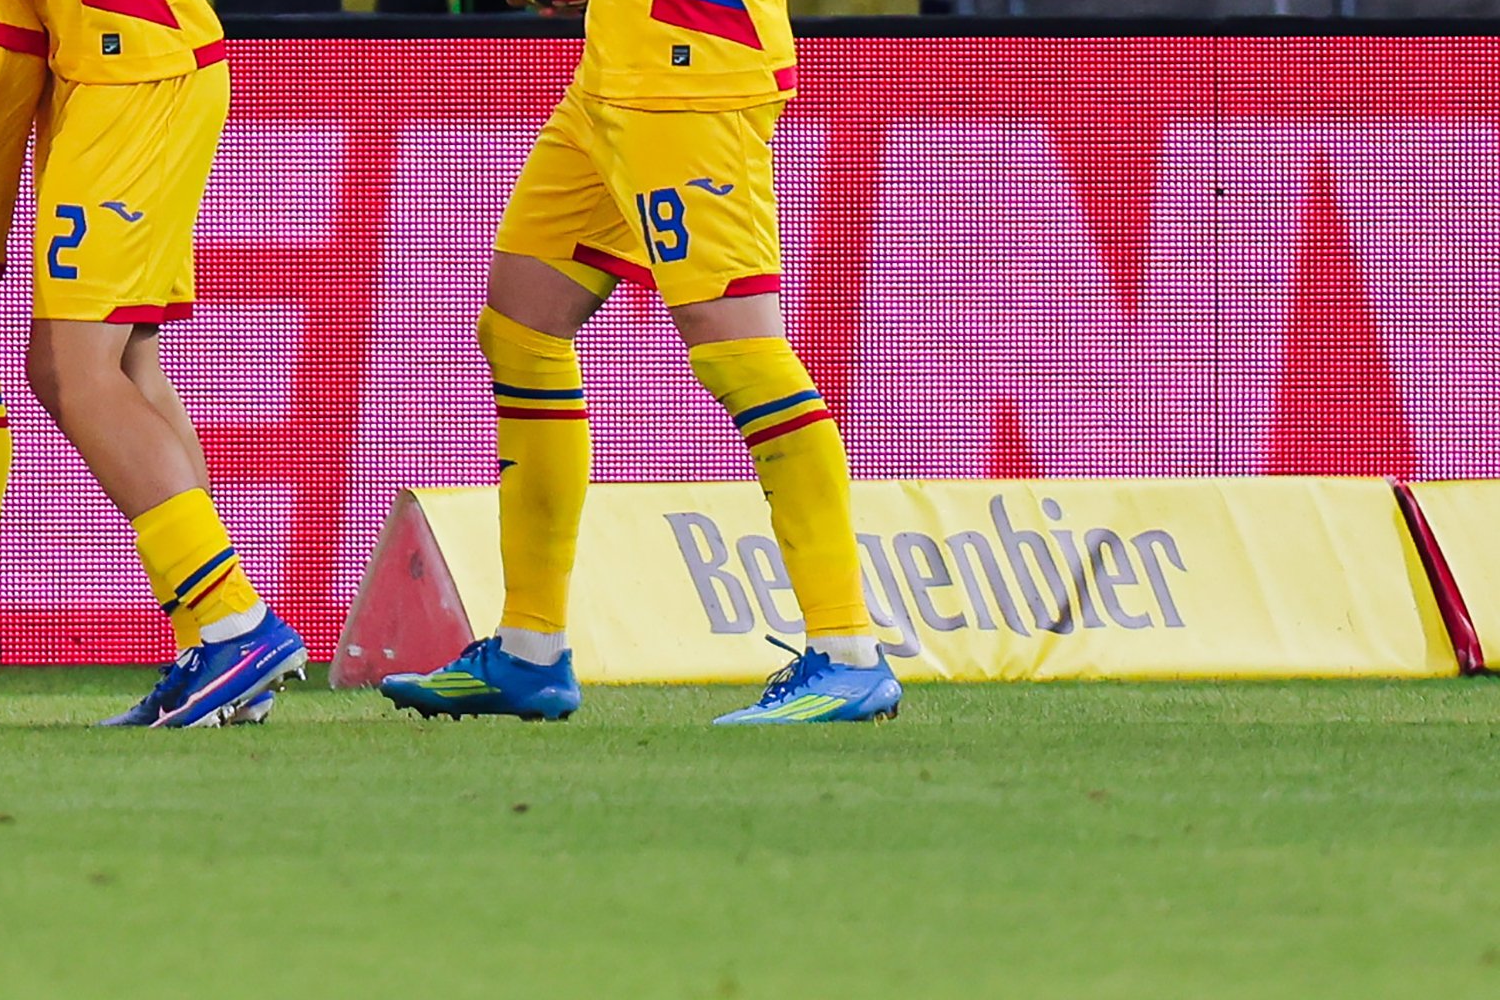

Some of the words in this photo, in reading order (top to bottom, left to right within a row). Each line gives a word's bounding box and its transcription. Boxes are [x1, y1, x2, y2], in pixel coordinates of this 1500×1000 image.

[47, 204, 88, 280] 2
[636, 187, 690, 265] 19
[662, 494, 1189, 658] Begenbier
